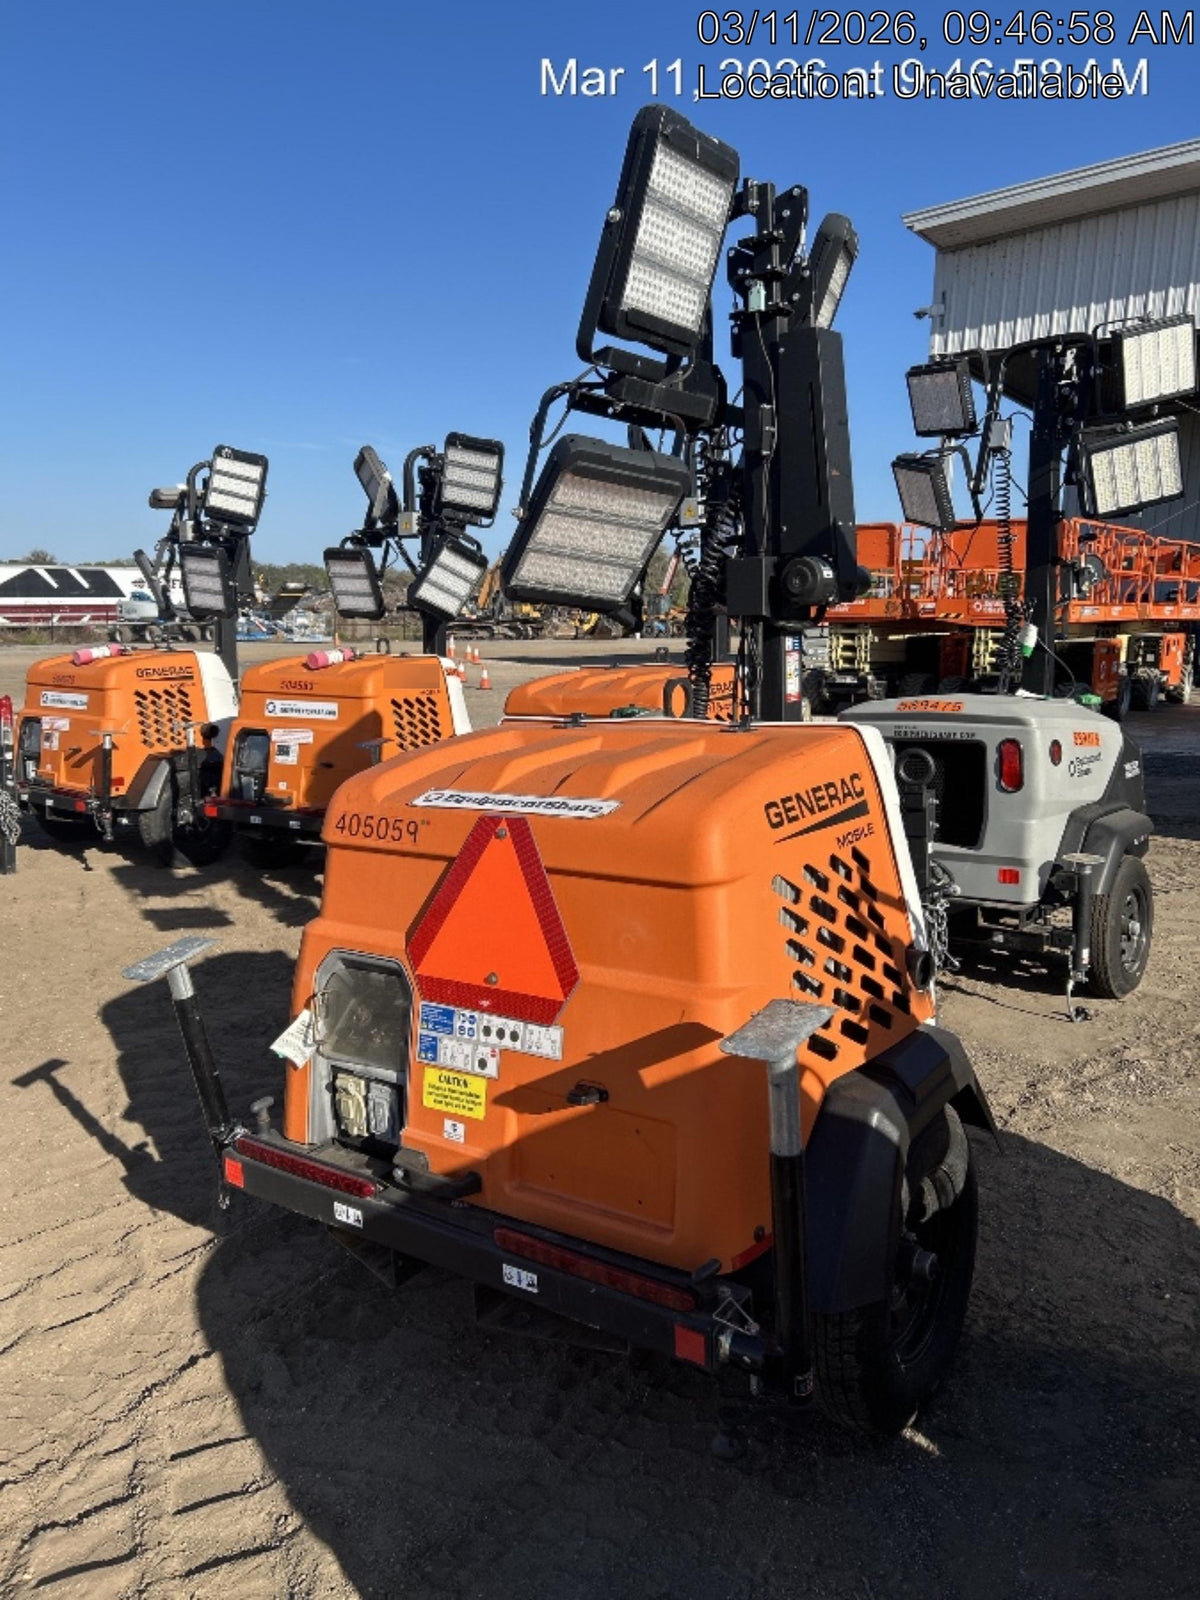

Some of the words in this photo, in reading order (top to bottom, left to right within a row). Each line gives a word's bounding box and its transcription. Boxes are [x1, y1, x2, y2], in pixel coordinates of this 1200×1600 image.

[136, 666, 194, 678] GENERAC
[444, 794, 604, 813] EquipmentShare
[764, 772, 866, 829] GENERAC
[335, 813, 419, 843] 405059
